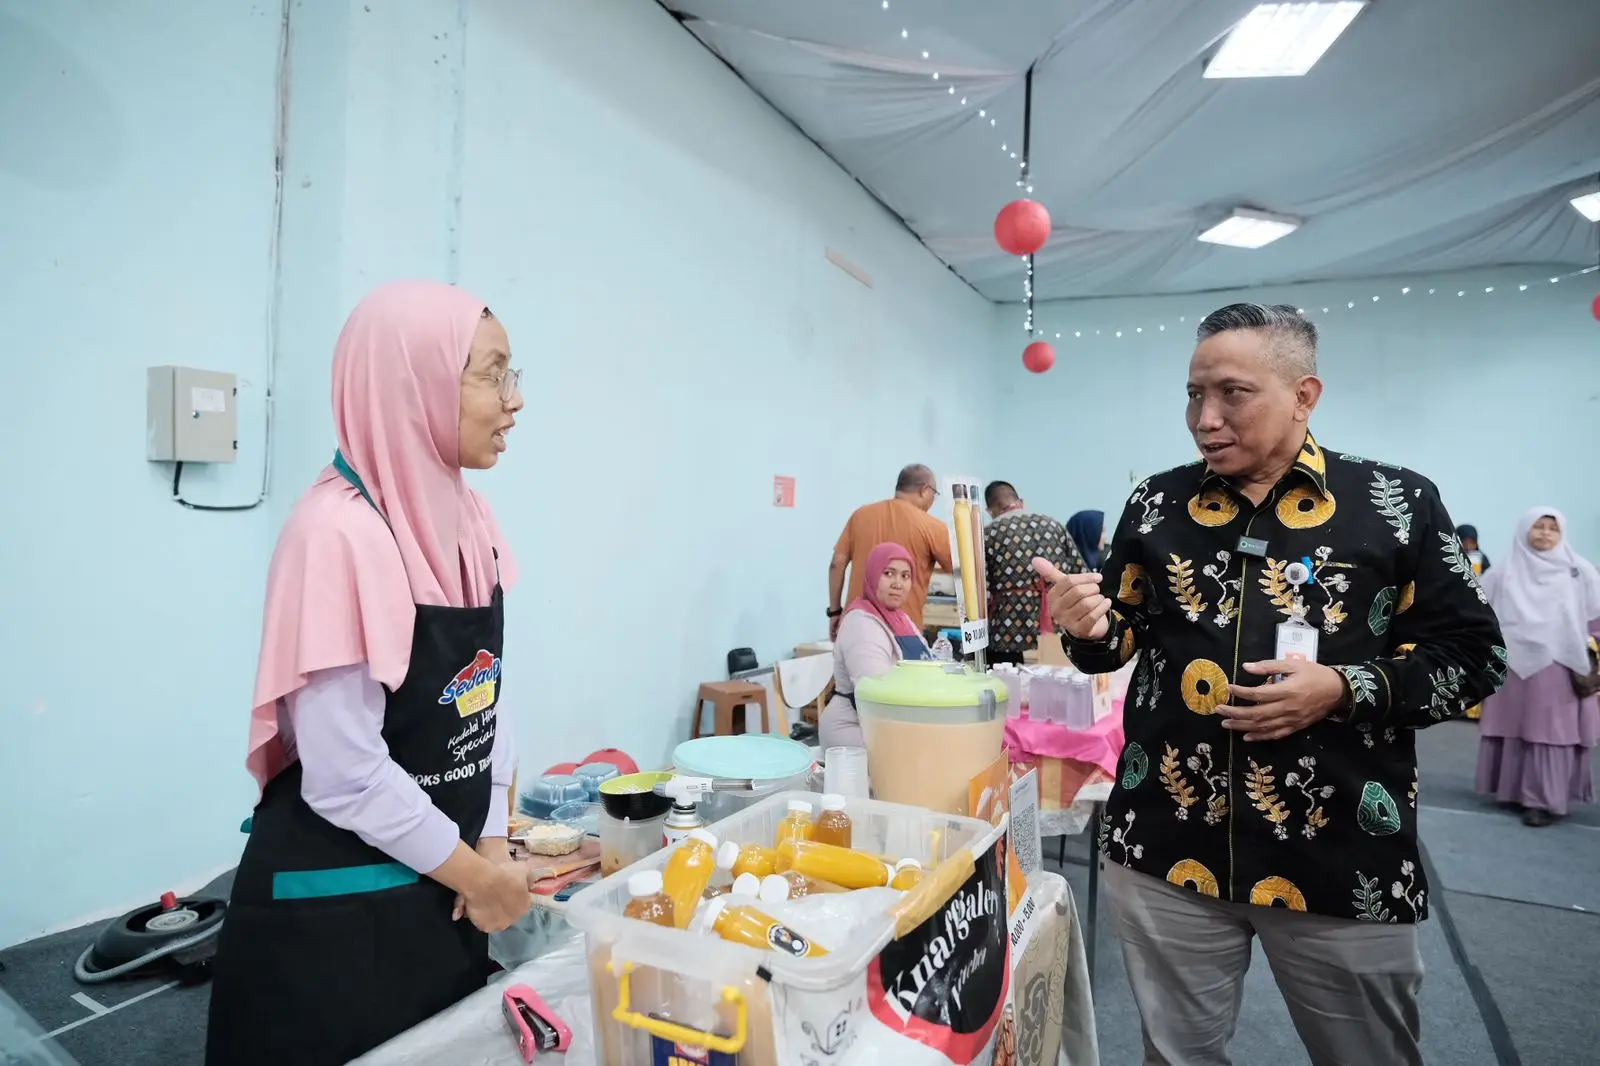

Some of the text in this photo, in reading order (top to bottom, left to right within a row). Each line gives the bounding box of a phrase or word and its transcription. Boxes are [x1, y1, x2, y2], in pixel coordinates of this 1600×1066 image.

[438, 658, 501, 704] Sedaap
[453, 723, 495, 762] Special
[444, 763, 476, 782] GOOD
